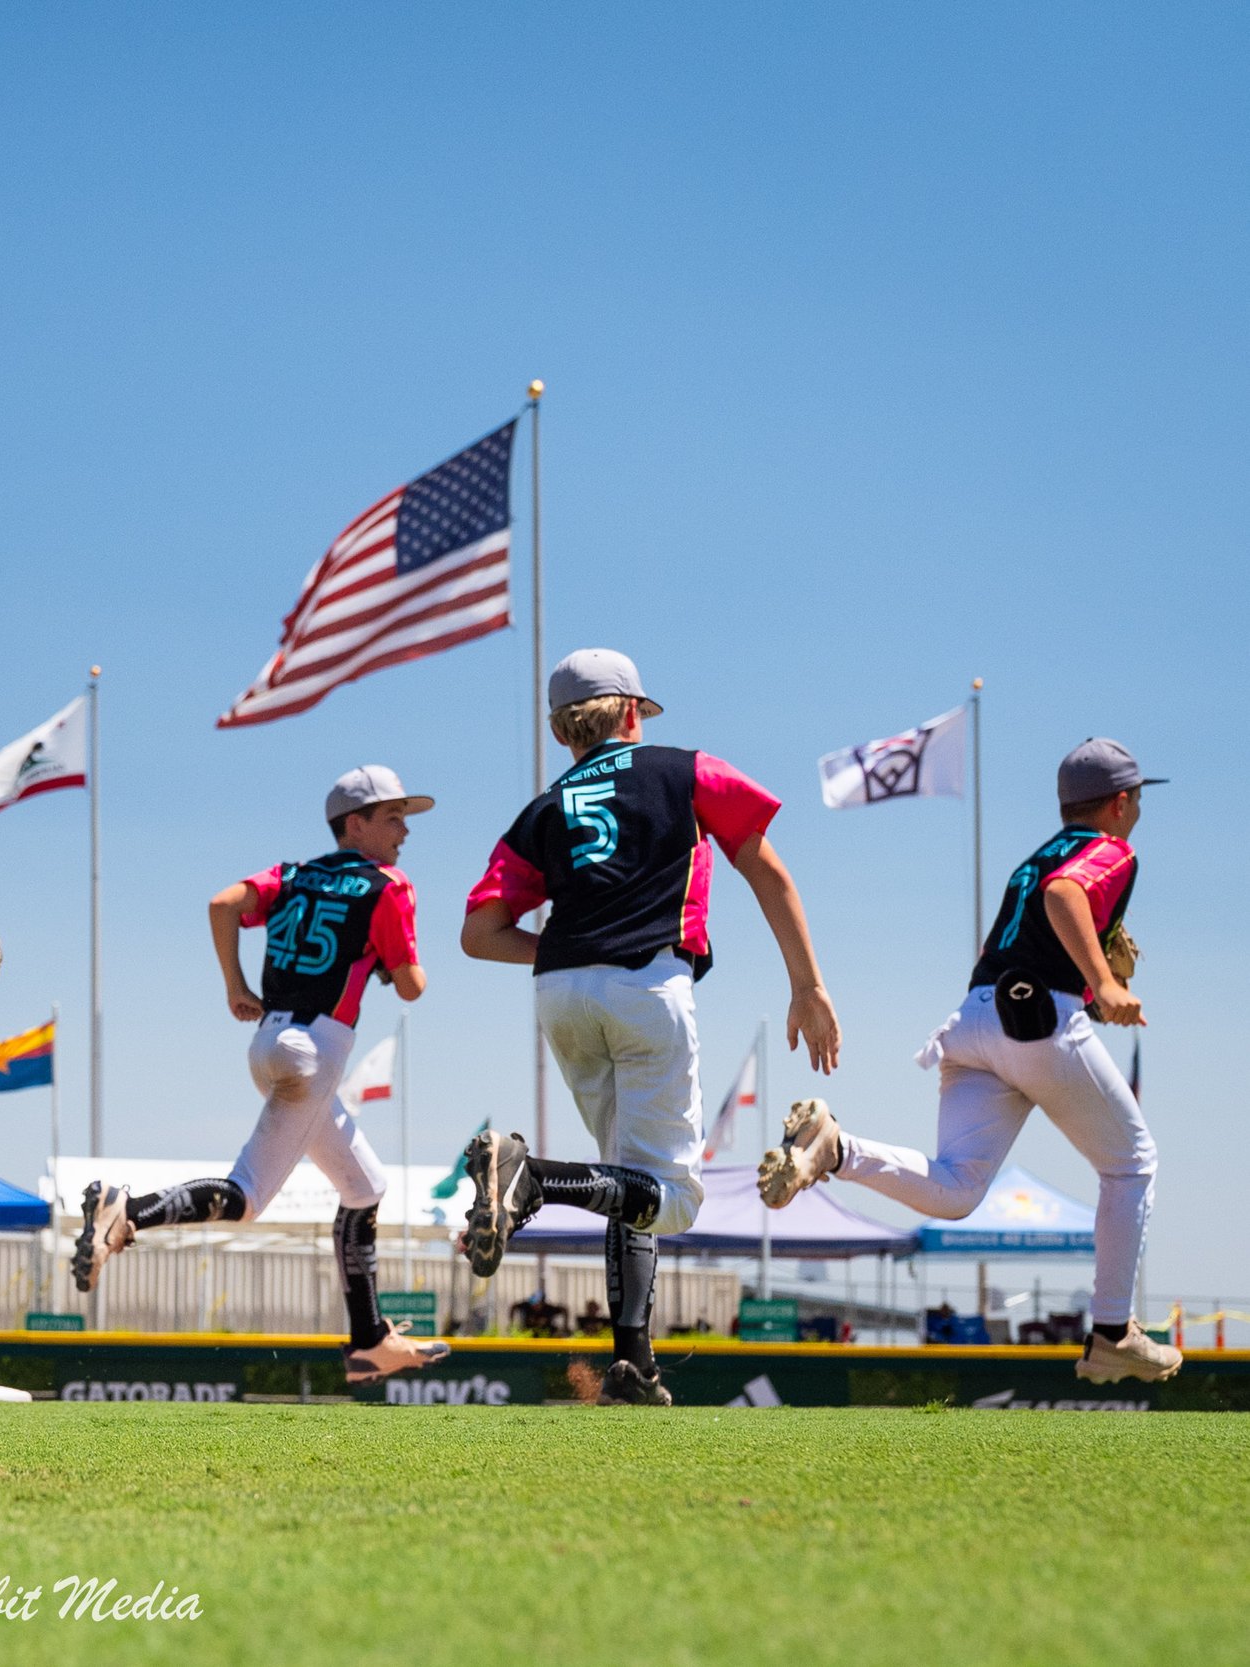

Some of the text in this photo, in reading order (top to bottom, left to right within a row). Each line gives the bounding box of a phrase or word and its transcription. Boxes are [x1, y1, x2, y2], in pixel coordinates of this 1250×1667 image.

[562, 780, 619, 870] 5
[266, 892, 348, 975] 45
[61, 1381, 236, 1401] GATORADE
[386, 1374, 510, 1404] DICK'S
